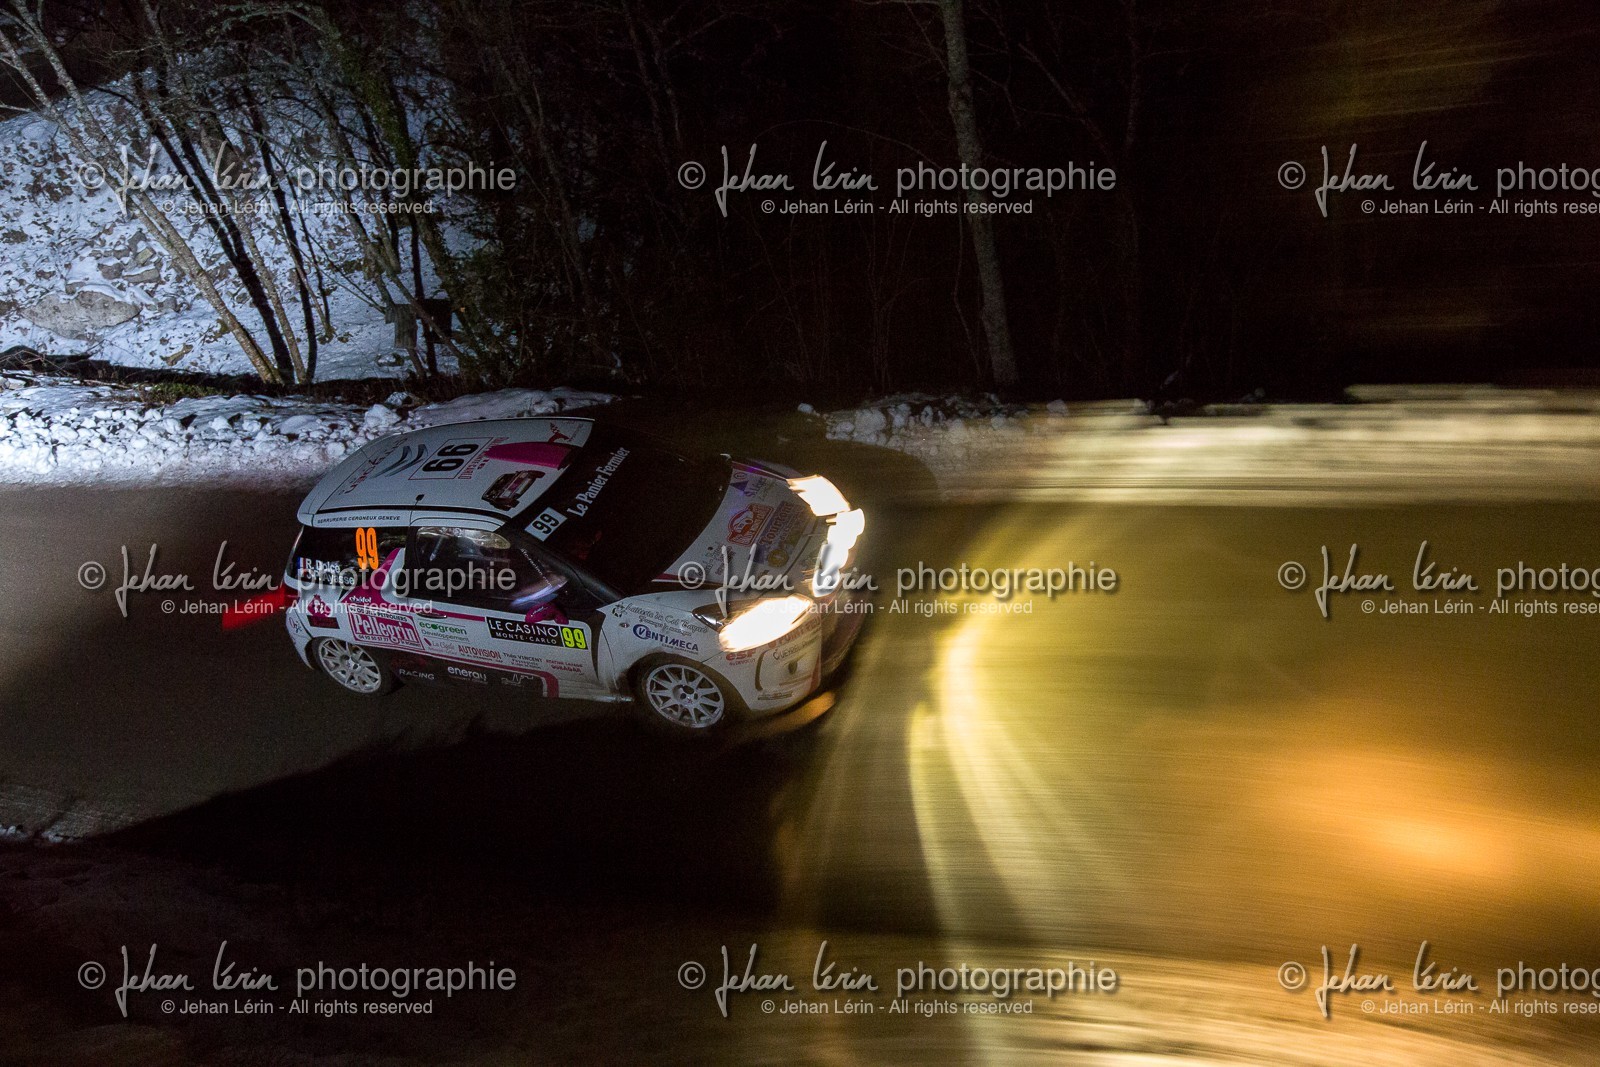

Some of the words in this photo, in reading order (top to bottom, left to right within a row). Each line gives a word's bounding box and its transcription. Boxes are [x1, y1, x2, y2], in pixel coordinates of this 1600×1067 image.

[422, 443, 479, 472] 99
[596, 447, 631, 478] Fermier
[575, 473, 609, 505] Panier
[567, 500, 589, 517] Le
[532, 513, 560, 535] 99
[355, 527, 379, 570] 99
[354, 614, 418, 644] Pellegrin
[488, 620, 503, 631] LE
[505, 623, 559, 638] CASINO
[562, 627, 586, 649] 99
[634, 624, 699, 651] VENTIMECA
